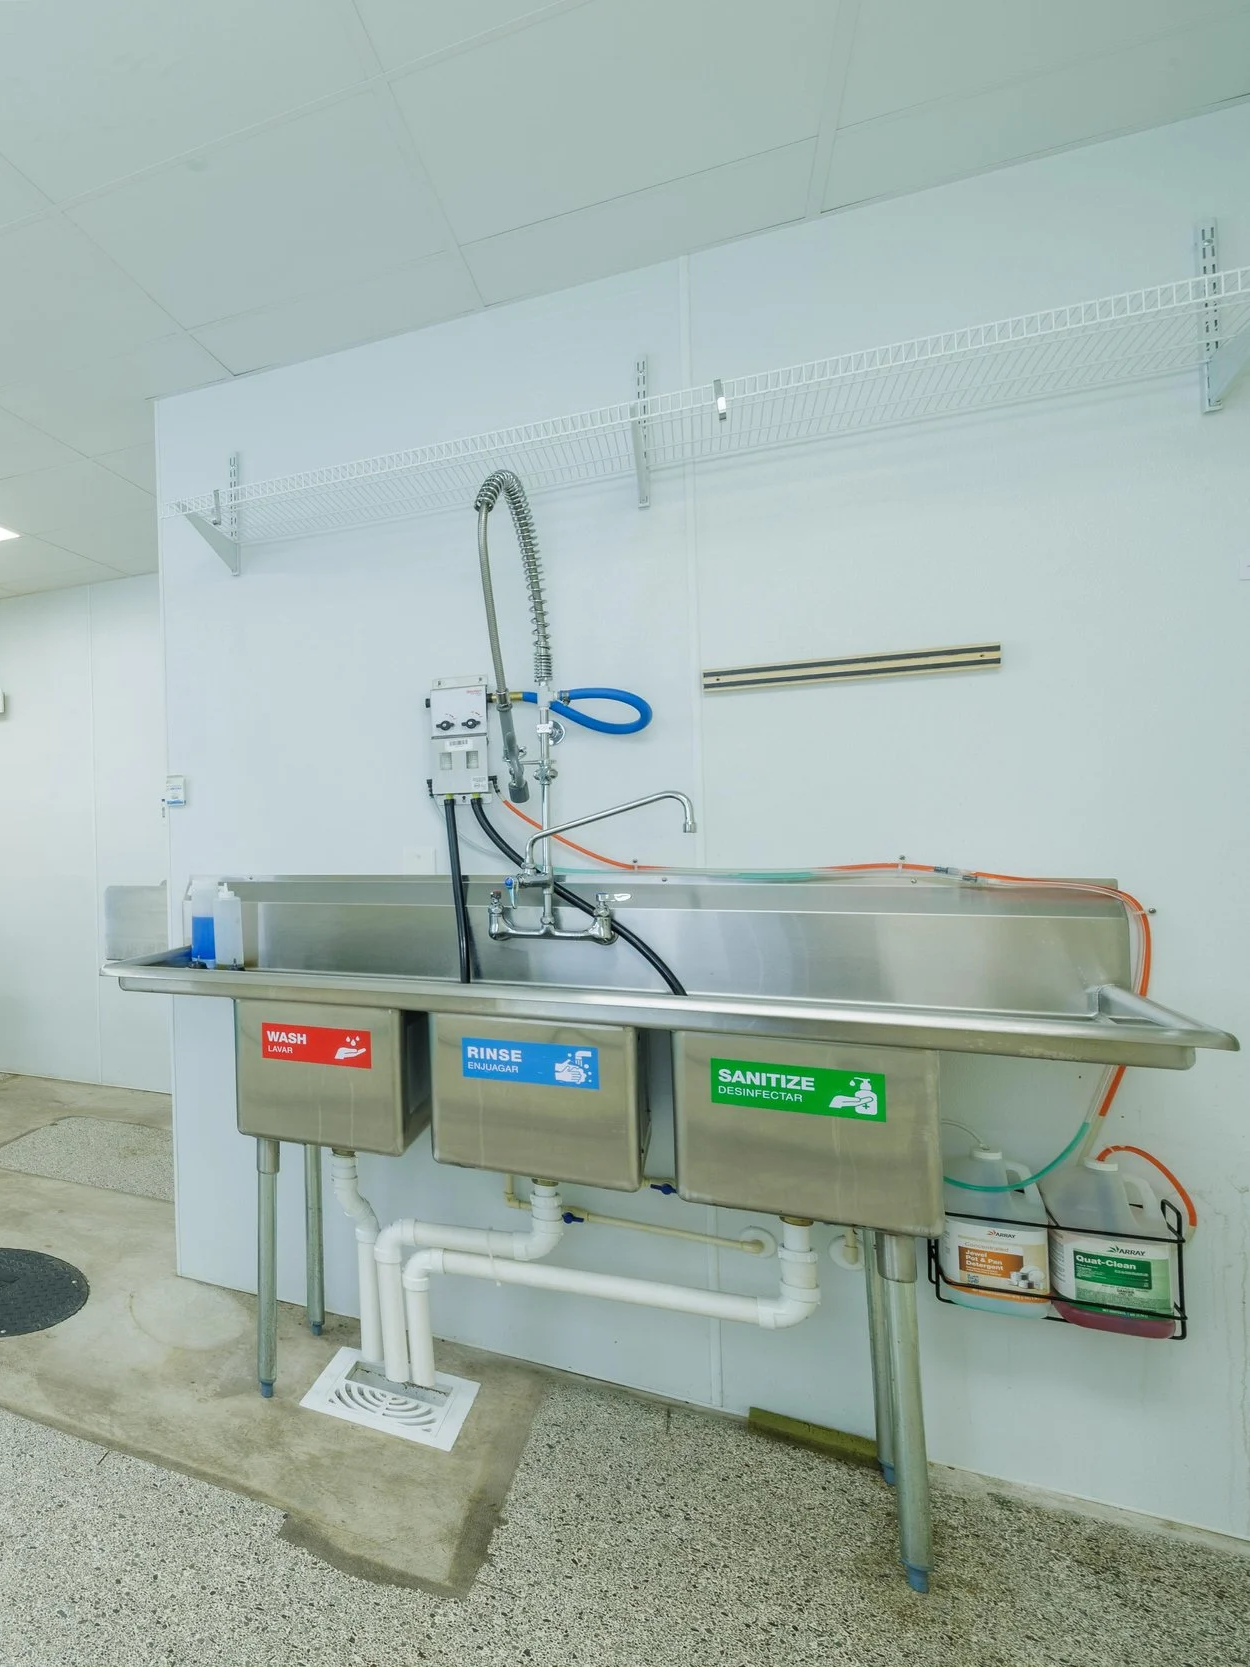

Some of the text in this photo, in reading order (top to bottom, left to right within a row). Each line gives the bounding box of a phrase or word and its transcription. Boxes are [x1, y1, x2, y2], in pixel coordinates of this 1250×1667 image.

[266, 1030, 307, 1045] WASH
[267, 1045, 293, 1054] LAVAR
[467, 1046, 523, 1062] RINSE
[467, 1061, 519, 1073] ENJUAGAR
[718, 1068, 815, 1091] SANITIZE
[718, 1085, 803, 1103] DESINFECTAR
[965, 1250, 988, 1258] Jewel
[1118, 1248, 1146, 1256] ARRAY
[965, 1260, 1004, 1271] Detergent
[1075, 1254, 1137, 1270] Quat-Clean
